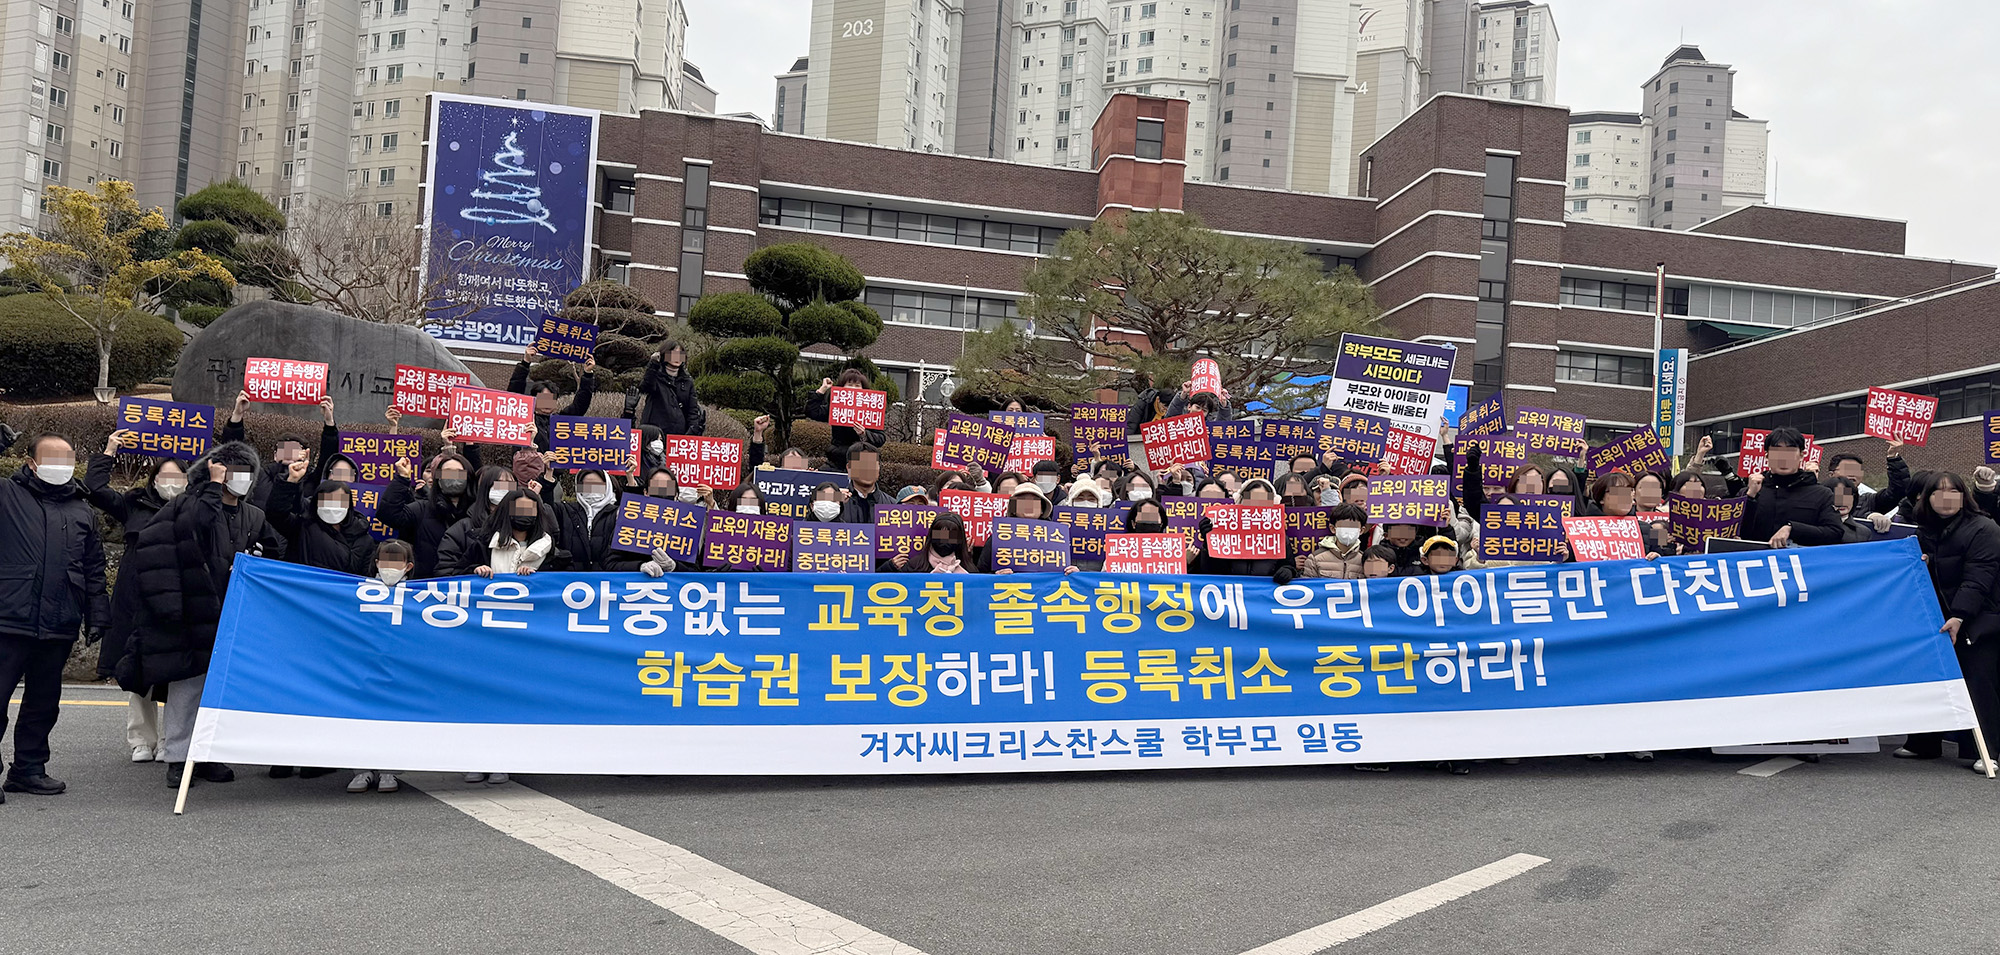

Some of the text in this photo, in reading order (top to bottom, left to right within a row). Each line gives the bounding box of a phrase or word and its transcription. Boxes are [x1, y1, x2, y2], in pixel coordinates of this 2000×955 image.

[842, 18, 873, 38] 203
[486, 235, 534, 252] Merry
[448, 240, 564, 271] Christmas
[504, 277, 552, 296] 따뜻했고,
[542, 319, 593, 342] 등록취소
[537, 337, 591, 359] 중단하라!
[1344, 342, 1449, 370] 학부모도 세금내는
[248, 360, 325, 380] 교육청 졸속행정
[396, 368, 426, 391] 교육청
[1363, 363, 1423, 384] 시민이다
[1661, 357, 1675, 395] 되세요.
[248, 378, 321, 401] 학생만 다친다!
[831, 390, 885, 410] 교육청 졸속행정
[1347, 383, 1382, 398] 부모와
[1384, 388, 1431, 405] 아이들이
[396, 390, 427, 413] 학생만
[1343, 397, 1390, 414] 사랑하는
[1392, 403, 1428, 419] 배움터
[1660, 399, 1672, 422] 하루
[1868, 391, 1935, 421] 교육청 졸속행정
[123, 403, 208, 429] 등록취소
[832, 407, 882, 427] 학생만 다친다!
[1073, 407, 1127, 423] 교육의 자율성
[1322, 413, 1384, 436] 등록취소
[1460, 399, 1500, 431] 등록취소
[1517, 410, 1584, 434] 교육의 자율성
[554, 422, 627, 441] 등록취소
[949, 419, 983, 440] 교육의
[984, 425, 1013, 448] 자율성
[1073, 426, 1125, 441] 보장하라!
[1142, 415, 1204, 444] 교육청 졸속행정
[1207, 425, 1251, 439] 록취소
[1265, 423, 1316, 439] 등록취소
[1868, 413, 1927, 443] 학생만 다친다!
[121, 431, 205, 455] 중단하라!
[342, 437, 419, 458] 교육의 자율성
[668, 439, 740, 463] 교육청 졸속행정
[1022, 440, 1053, 456] 졸속행정
[1148, 445, 1172, 467] 학생만
[1174, 438, 1207, 461] 다친다!
[1214, 444, 1272, 461] 등록취소
[1318, 434, 1381, 458] 중단하라!
[1386, 430, 1434, 458] 육청 졸속행정
[1493, 441, 1526, 460] 자율성
[1591, 428, 1657, 469] 교육의 자율성
[554, 447, 625, 465] 중단하라!
[945, 442, 1007, 469] 보장하라!
[1400, 455, 1428, 476] 다친다!
[670, 462, 736, 485] 학생만 다친다!
[758, 481, 795, 497] 학교가
[1369, 479, 1406, 497] 교육의
[1410, 479, 1448, 497] 자율성
[623, 500, 698, 529] 등록취소
[877, 509, 913, 529] 교육의
[1057, 511, 1125, 531] 등록취소
[1165, 501, 1198, 520] 교육의
[1208, 509, 1239, 530] 교육청
[1241, 508, 1282, 530] 졸속행정
[1484, 511, 1558, 530] 등록취소
[1671, 498, 1744, 522] 교육의 자율성
[709, 516, 789, 543] 교육의 자율성
[797, 527, 870, 547] 등록취소
[996, 523, 1066, 544] 등록취소
[1565, 519, 1598, 538] 교육청
[1597, 519, 1639, 539] 졸속행정
[1671, 521, 1739, 545] 보장하라!
[617, 526, 693, 556] 중단하라!
[1108, 538, 1139, 559] 교육청
[1141, 537, 1183, 559] 졸속행정
[1210, 533, 1242, 555] 학생만
[1245, 533, 1281, 555] 다친다!
[1575, 539, 1642, 560] 학생만 다친다!
[707, 542, 786, 568] 보장하라!
[796, 552, 869, 571] 중단하라!
[995, 548, 1066, 568] 중단하라!
[354, 554, 1809, 637] 학생은 안중없는 교육청 졸속행정에 우리 아이들만 다친다!
[636, 637, 1548, 708] 학습권 보장하라! 등록취소 중단하라!
[860, 721, 1365, 763] 겨자씨크리스찬스쿨 학부모 일동
